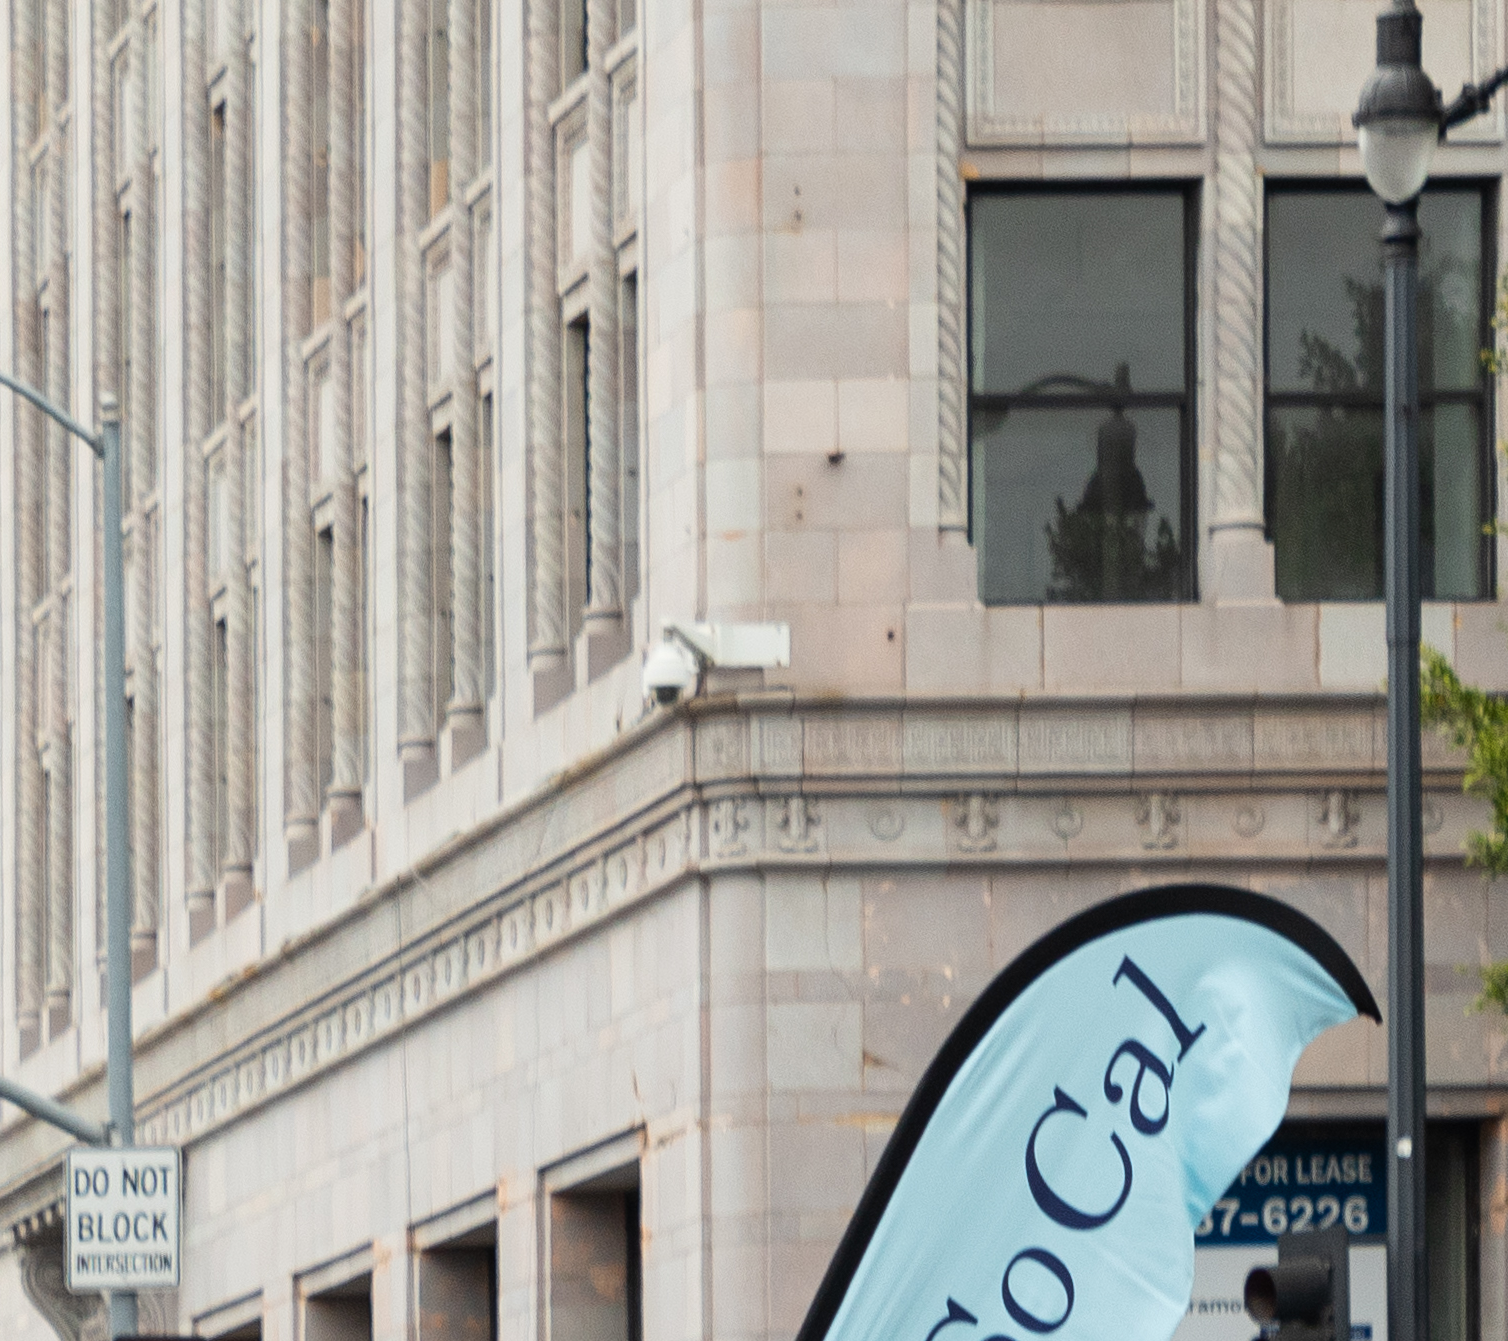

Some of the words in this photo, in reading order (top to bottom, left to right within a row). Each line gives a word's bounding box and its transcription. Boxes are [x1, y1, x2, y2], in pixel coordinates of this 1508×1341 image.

[74, 1166, 110, 1197] DO
[121, 1165, 173, 1197] NOT
[1295, 1153, 1373, 1185] LEASE
[78, 1211, 169, 1243] BLOCK
[76, 1253, 173, 1275] INTERSECTION
[1189, 1300, 1245, 1315] ramo
